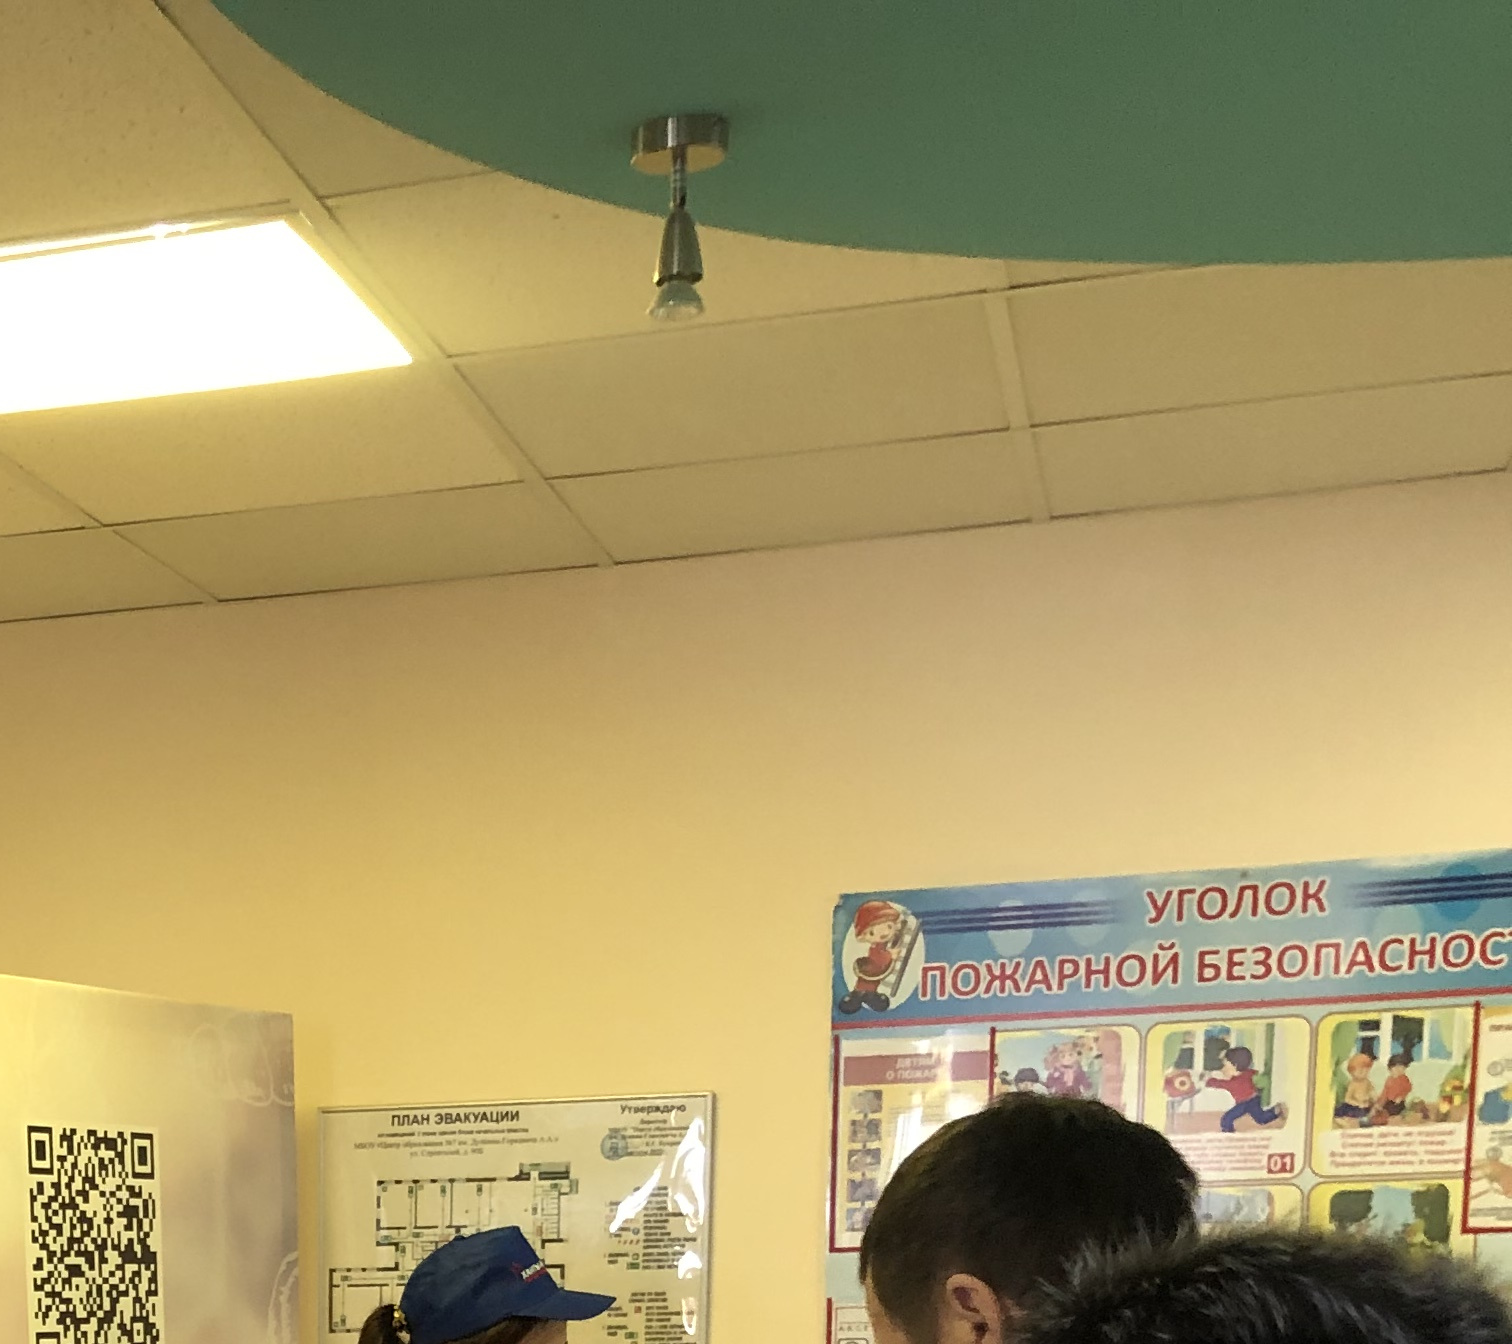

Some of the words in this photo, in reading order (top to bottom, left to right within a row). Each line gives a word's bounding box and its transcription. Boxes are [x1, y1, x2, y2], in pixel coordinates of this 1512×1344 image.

[1145, 879, 1329, 924] УГОЛОК
[919, 944, 1180, 1000] ПОЖАРНОЙ
[1196, 930, 1512, 984] БЕЗОПАСНОС
[620, 1104, 687, 1115] Утверждаю
[391, 1114, 430, 1127] ПЛАН
[434, 1110, 520, 1126] ЭВАКУАЦИИ
[1269, 1156, 1292, 1171] 01
